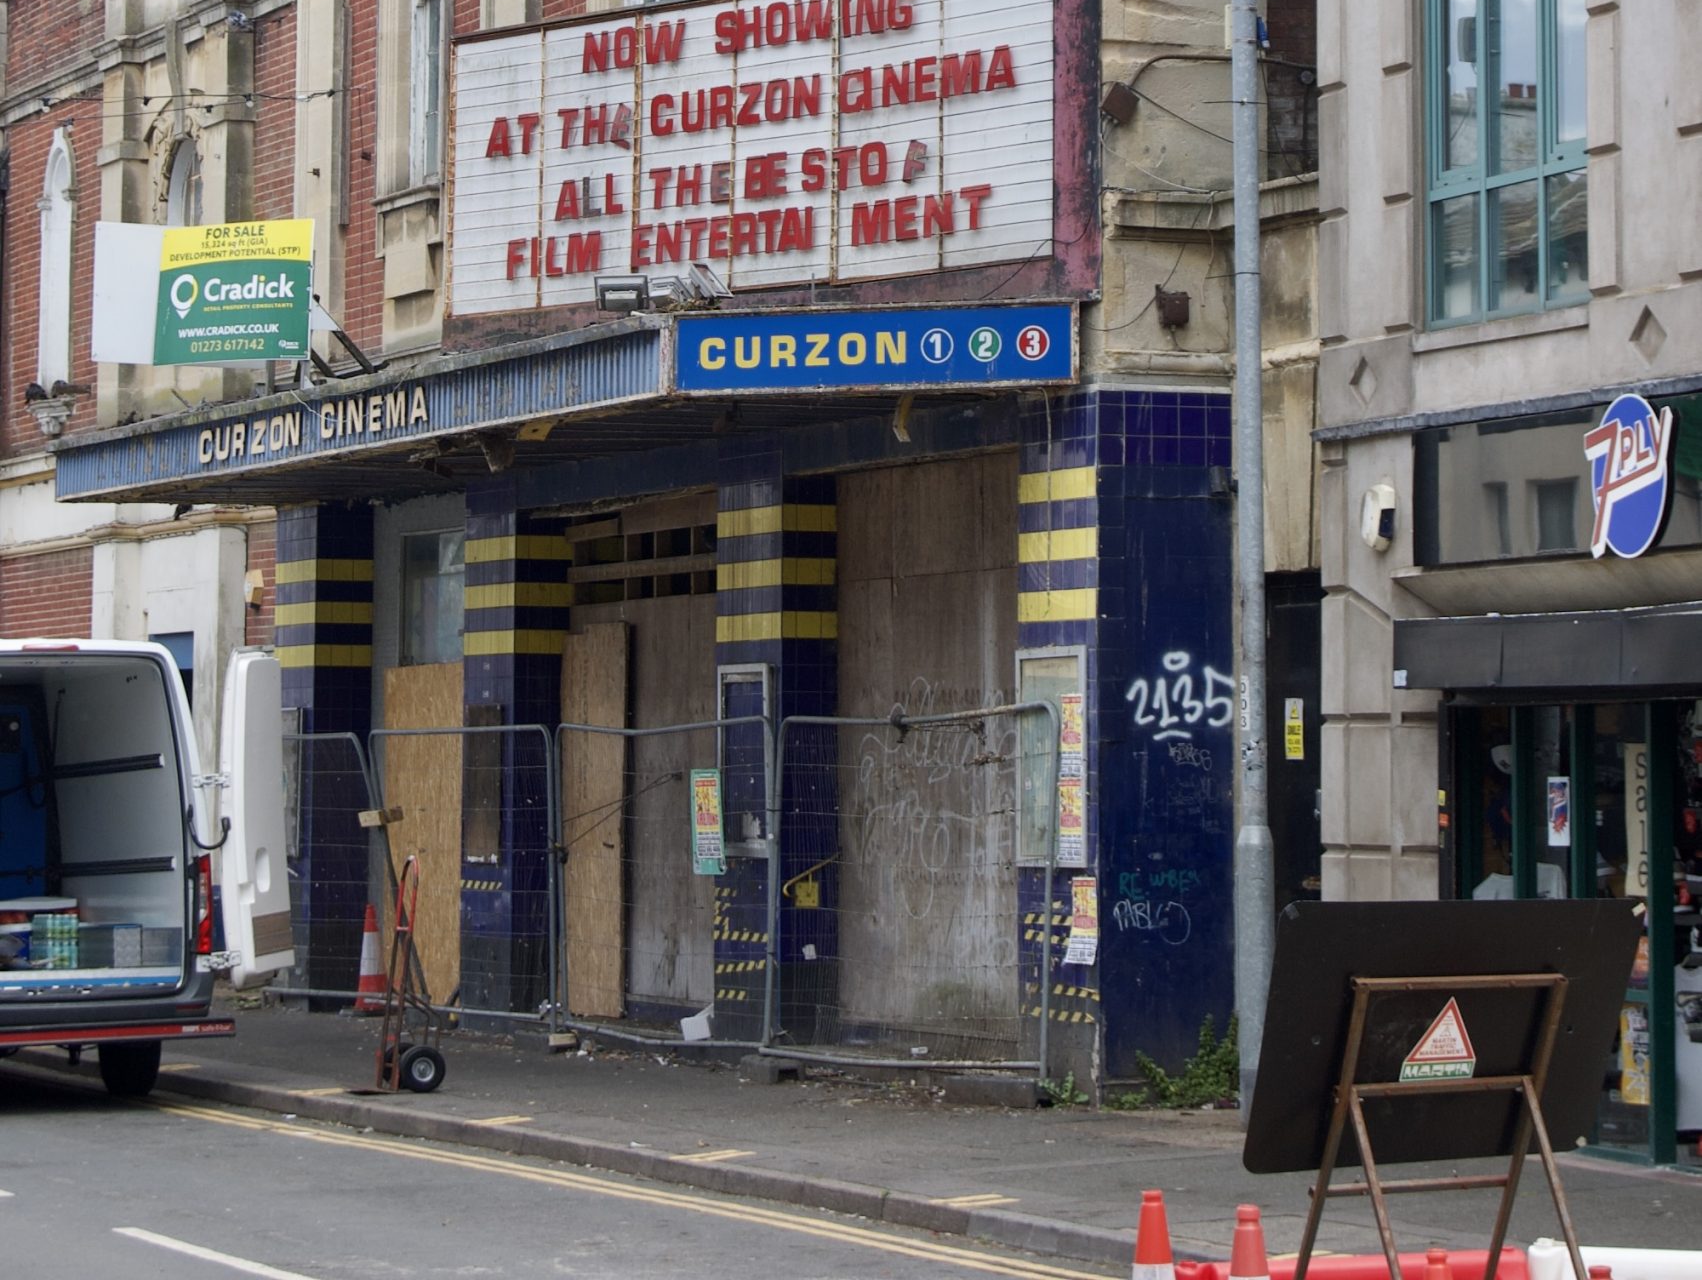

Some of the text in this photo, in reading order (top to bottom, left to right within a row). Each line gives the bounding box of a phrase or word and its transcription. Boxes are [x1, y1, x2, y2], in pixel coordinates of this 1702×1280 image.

[582, 18, 686, 73] NOW
[486, 45, 1016, 157] AT THE CURZON CINEMA
[554, 173, 624, 221] ALL
[649, 160, 731, 209] THE
[201, 241, 226, 249] 15,324
[238, 238, 245, 246] ft
[205, 225, 265, 239] FOR SALE
[506, 231, 602, 280] FILM
[852, 184, 991, 247] MENT
[170, 246, 301, 262] DEVELOPMENT POTENTIAL (STP)
[204, 273, 295, 302] Cradick
[178, 323, 279, 338] WWW.CRADICK.CO.UK
[190, 340, 222, 353] 01273
[224, 338, 265, 350] 617142
[699, 331, 907, 370] CURZON
[200, 386, 428, 464] CURZON CINEMA
